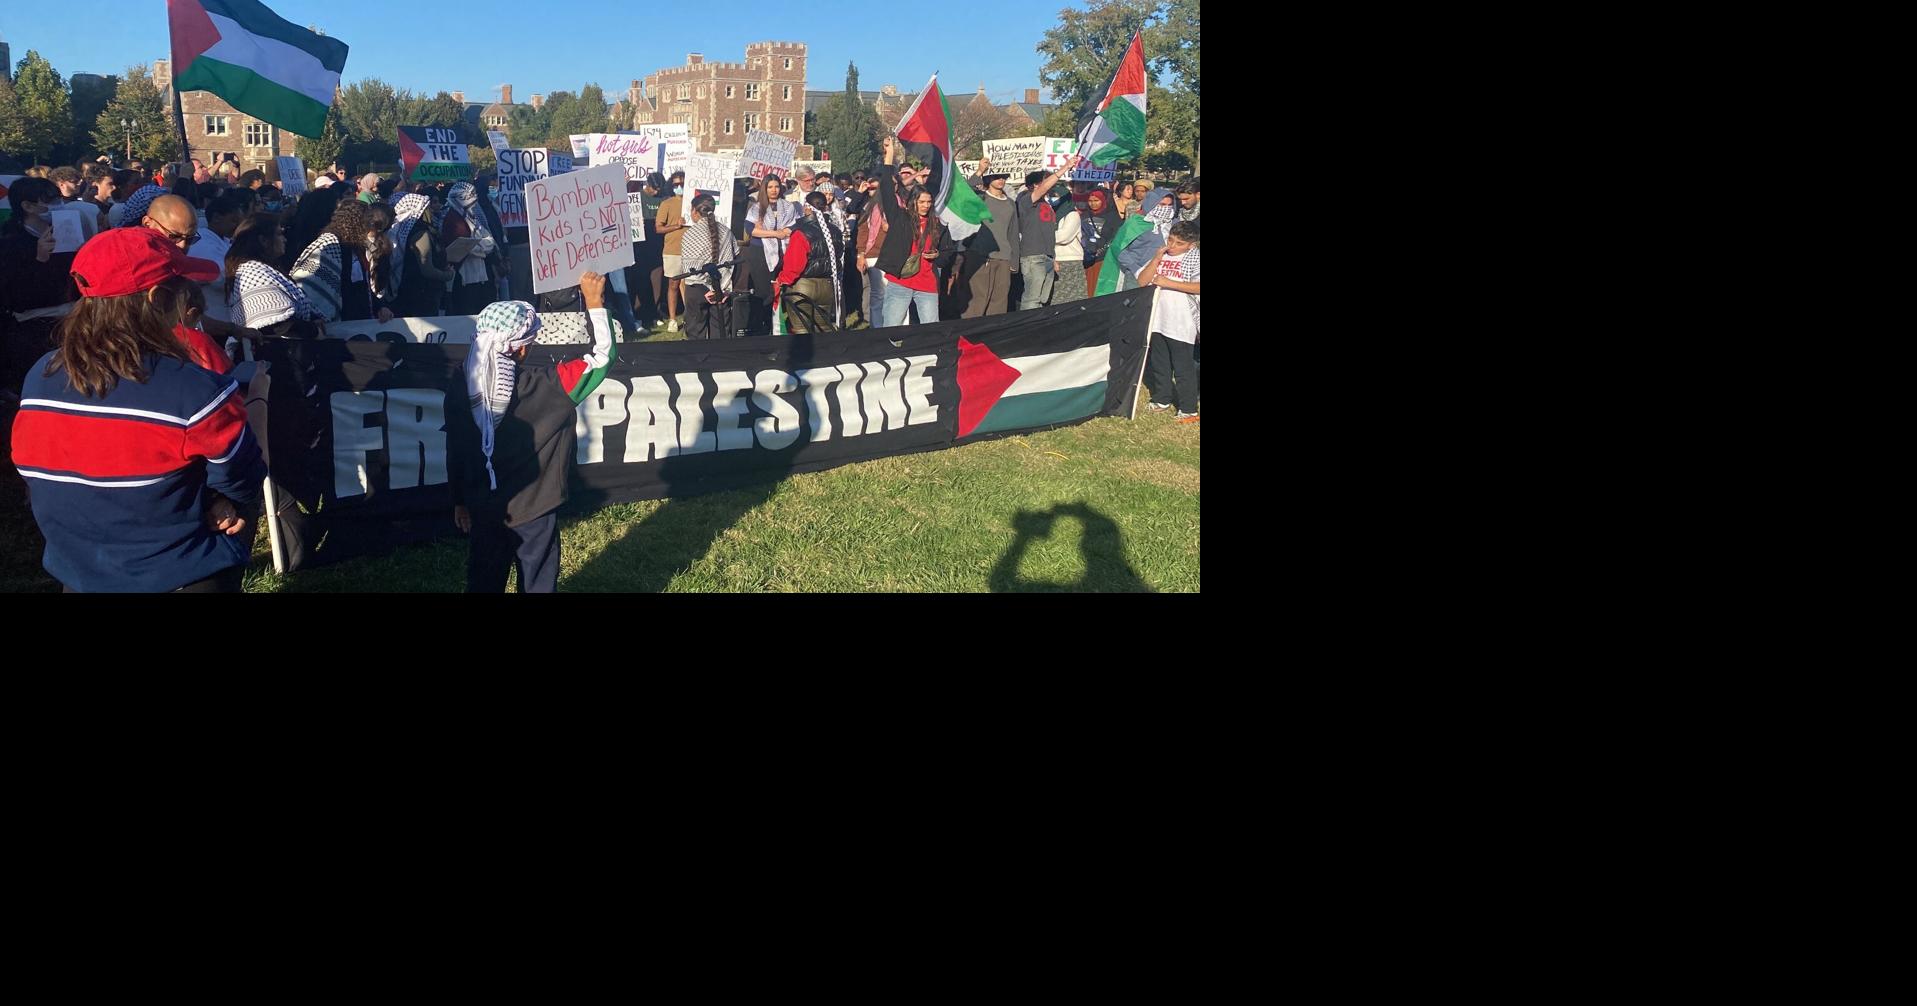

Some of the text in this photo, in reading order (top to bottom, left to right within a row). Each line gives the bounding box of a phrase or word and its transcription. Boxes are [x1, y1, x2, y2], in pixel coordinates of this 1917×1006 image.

[425, 128, 457, 143] END
[429, 145, 459, 161] THE
[596, 134, 622, 154] hot
[620, 136, 653, 157] girls
[987, 143, 1010, 154] HOW
[500, 149, 546, 175] STOP
[690, 157, 733, 169] END THE
[696, 168, 726, 179] SIEGE
[688, 179, 730, 191] ON GAZA
[531, 178, 614, 221] Bombing
[538, 220, 573, 246] Kids
[599, 202, 627, 227] NOT
[536, 223, 627, 281] Self Defense!!
[1157, 260, 1182, 270] FREE
[331, 354, 938, 498] FR PALESTINE
